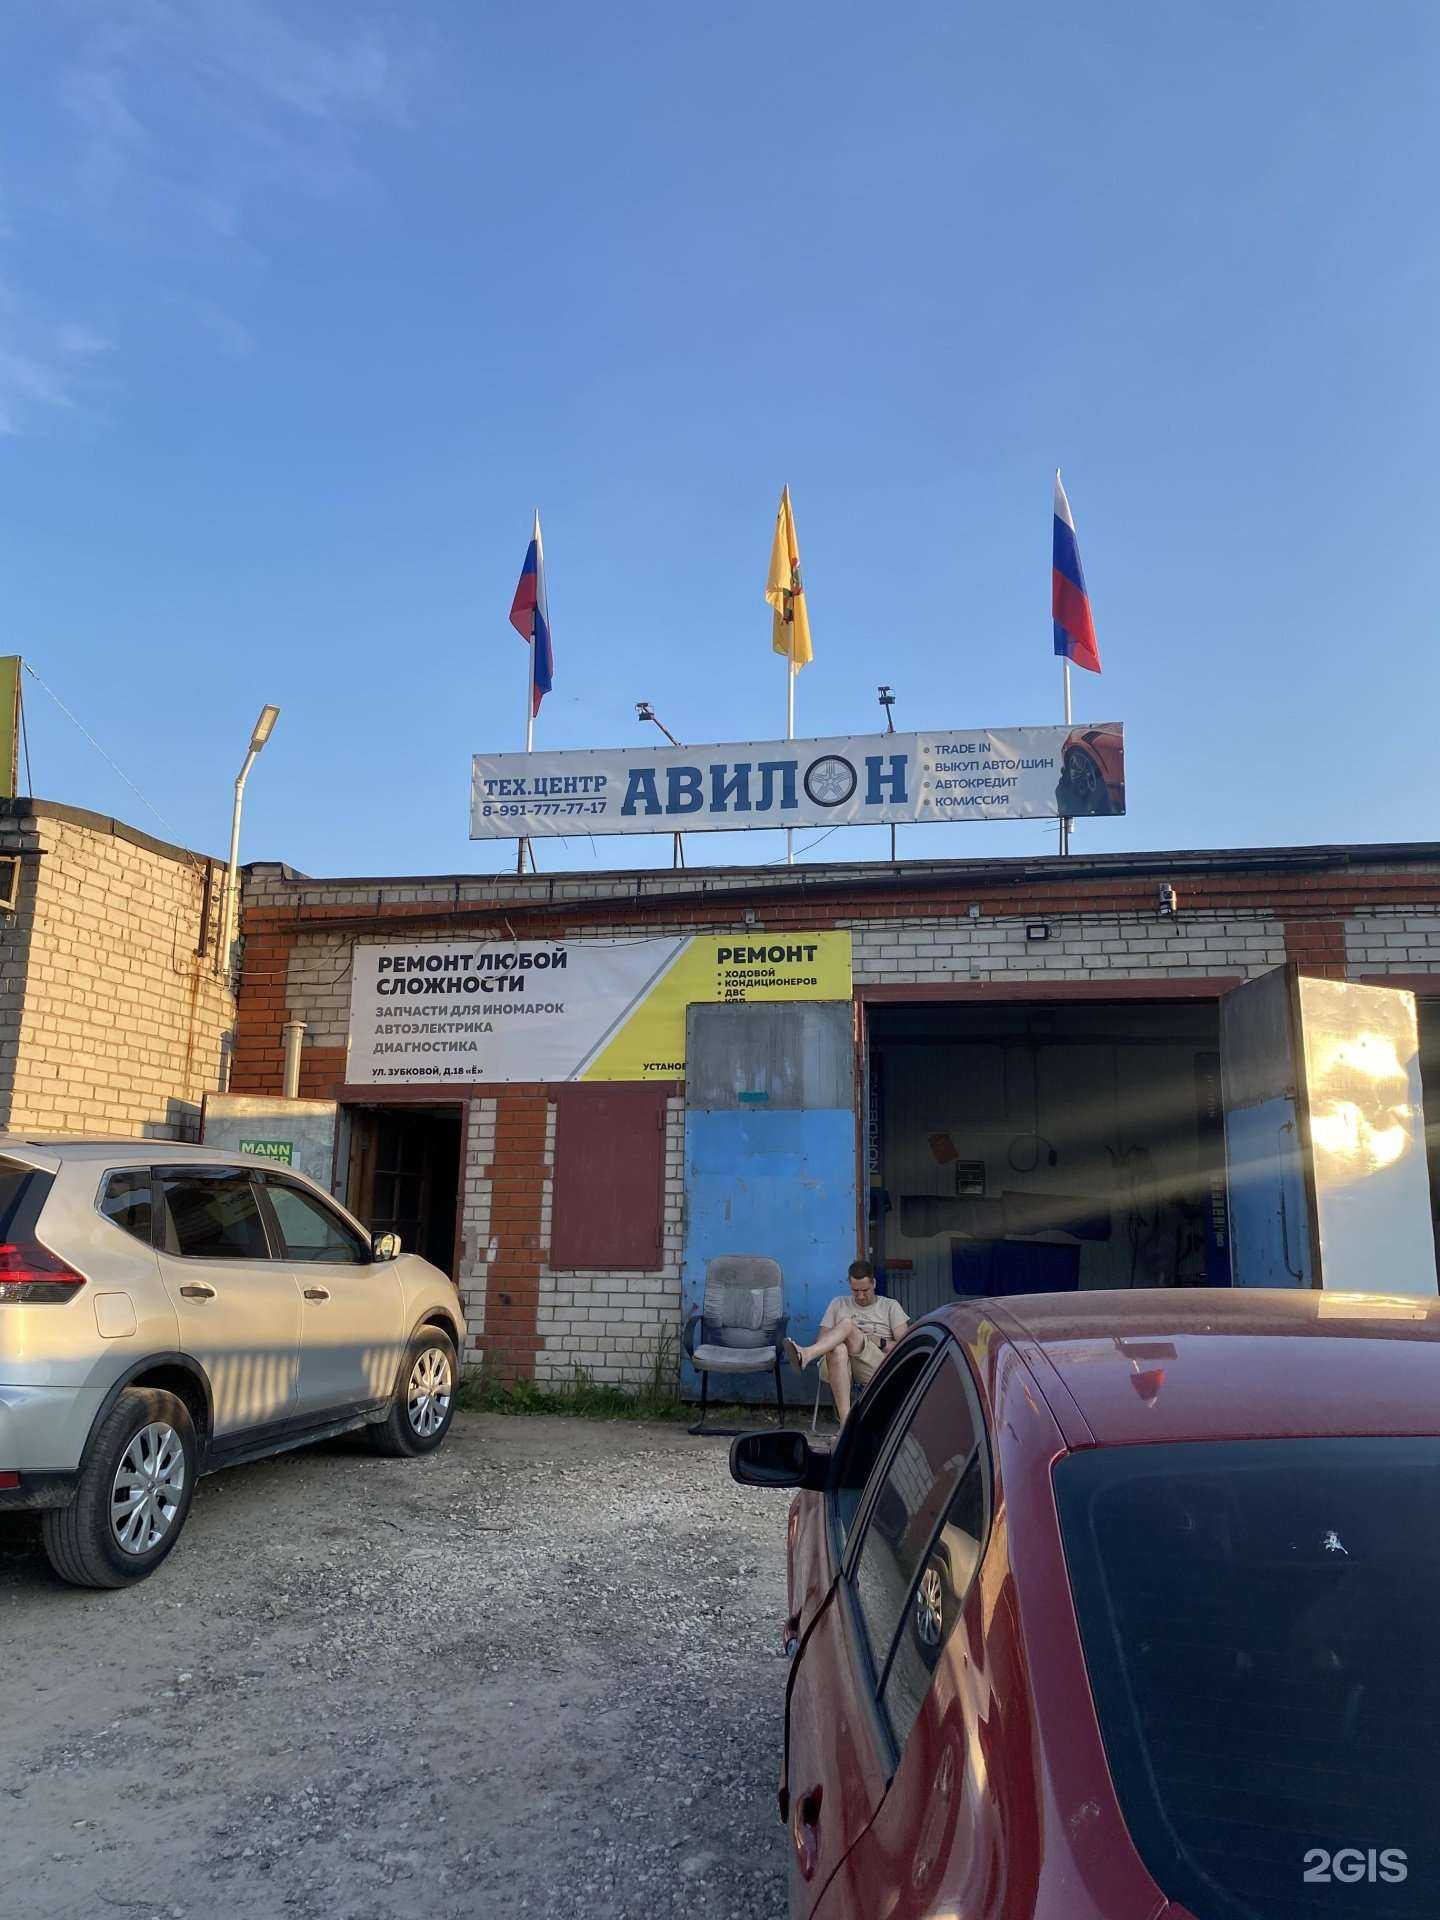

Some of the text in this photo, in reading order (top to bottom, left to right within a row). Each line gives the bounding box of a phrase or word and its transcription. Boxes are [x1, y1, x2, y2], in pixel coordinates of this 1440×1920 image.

[935, 743, 991, 755] TRADE IN
[935, 758, 1054, 773] ВЫКУП АВТО/ШИН
[483, 775, 608, 797] ТЕХ.ЦЕНТР
[935, 777, 1018, 789] АВТОКРЕДИТ
[935, 794, 1009, 807] КОМИССИЯ
[482, 801, 607, 817] 8-991-777-77-17
[378, 948, 568, 973] РЕМОНТ ЛЮБОЙ
[717, 945, 818, 965] РЕМОНТ
[725, 967, 775, 978] ХОДОВОЙ
[376, 975, 525, 995] СЛОЖНОСТИ
[724, 978, 817, 988] КОНДИЦИОНЕРОВ
[725, 989, 746, 998] ДВС
[375, 1002, 564, 1018] ЗАПЧАСТИ ДЛЯ ИНОМАРОК
[375, 1021, 493, 1035] АВТОЭЛЕКТРИКА
[373, 1040, 478, 1055] ДИАГНОСТИКА
[372, 1068, 386, 1076] УЛ.
[388, 1065, 441, 1077] ЗУБКОВОЙ,
[443, 1067, 464, 1077] Д.18
[241, 1143, 290, 1155] MANN
